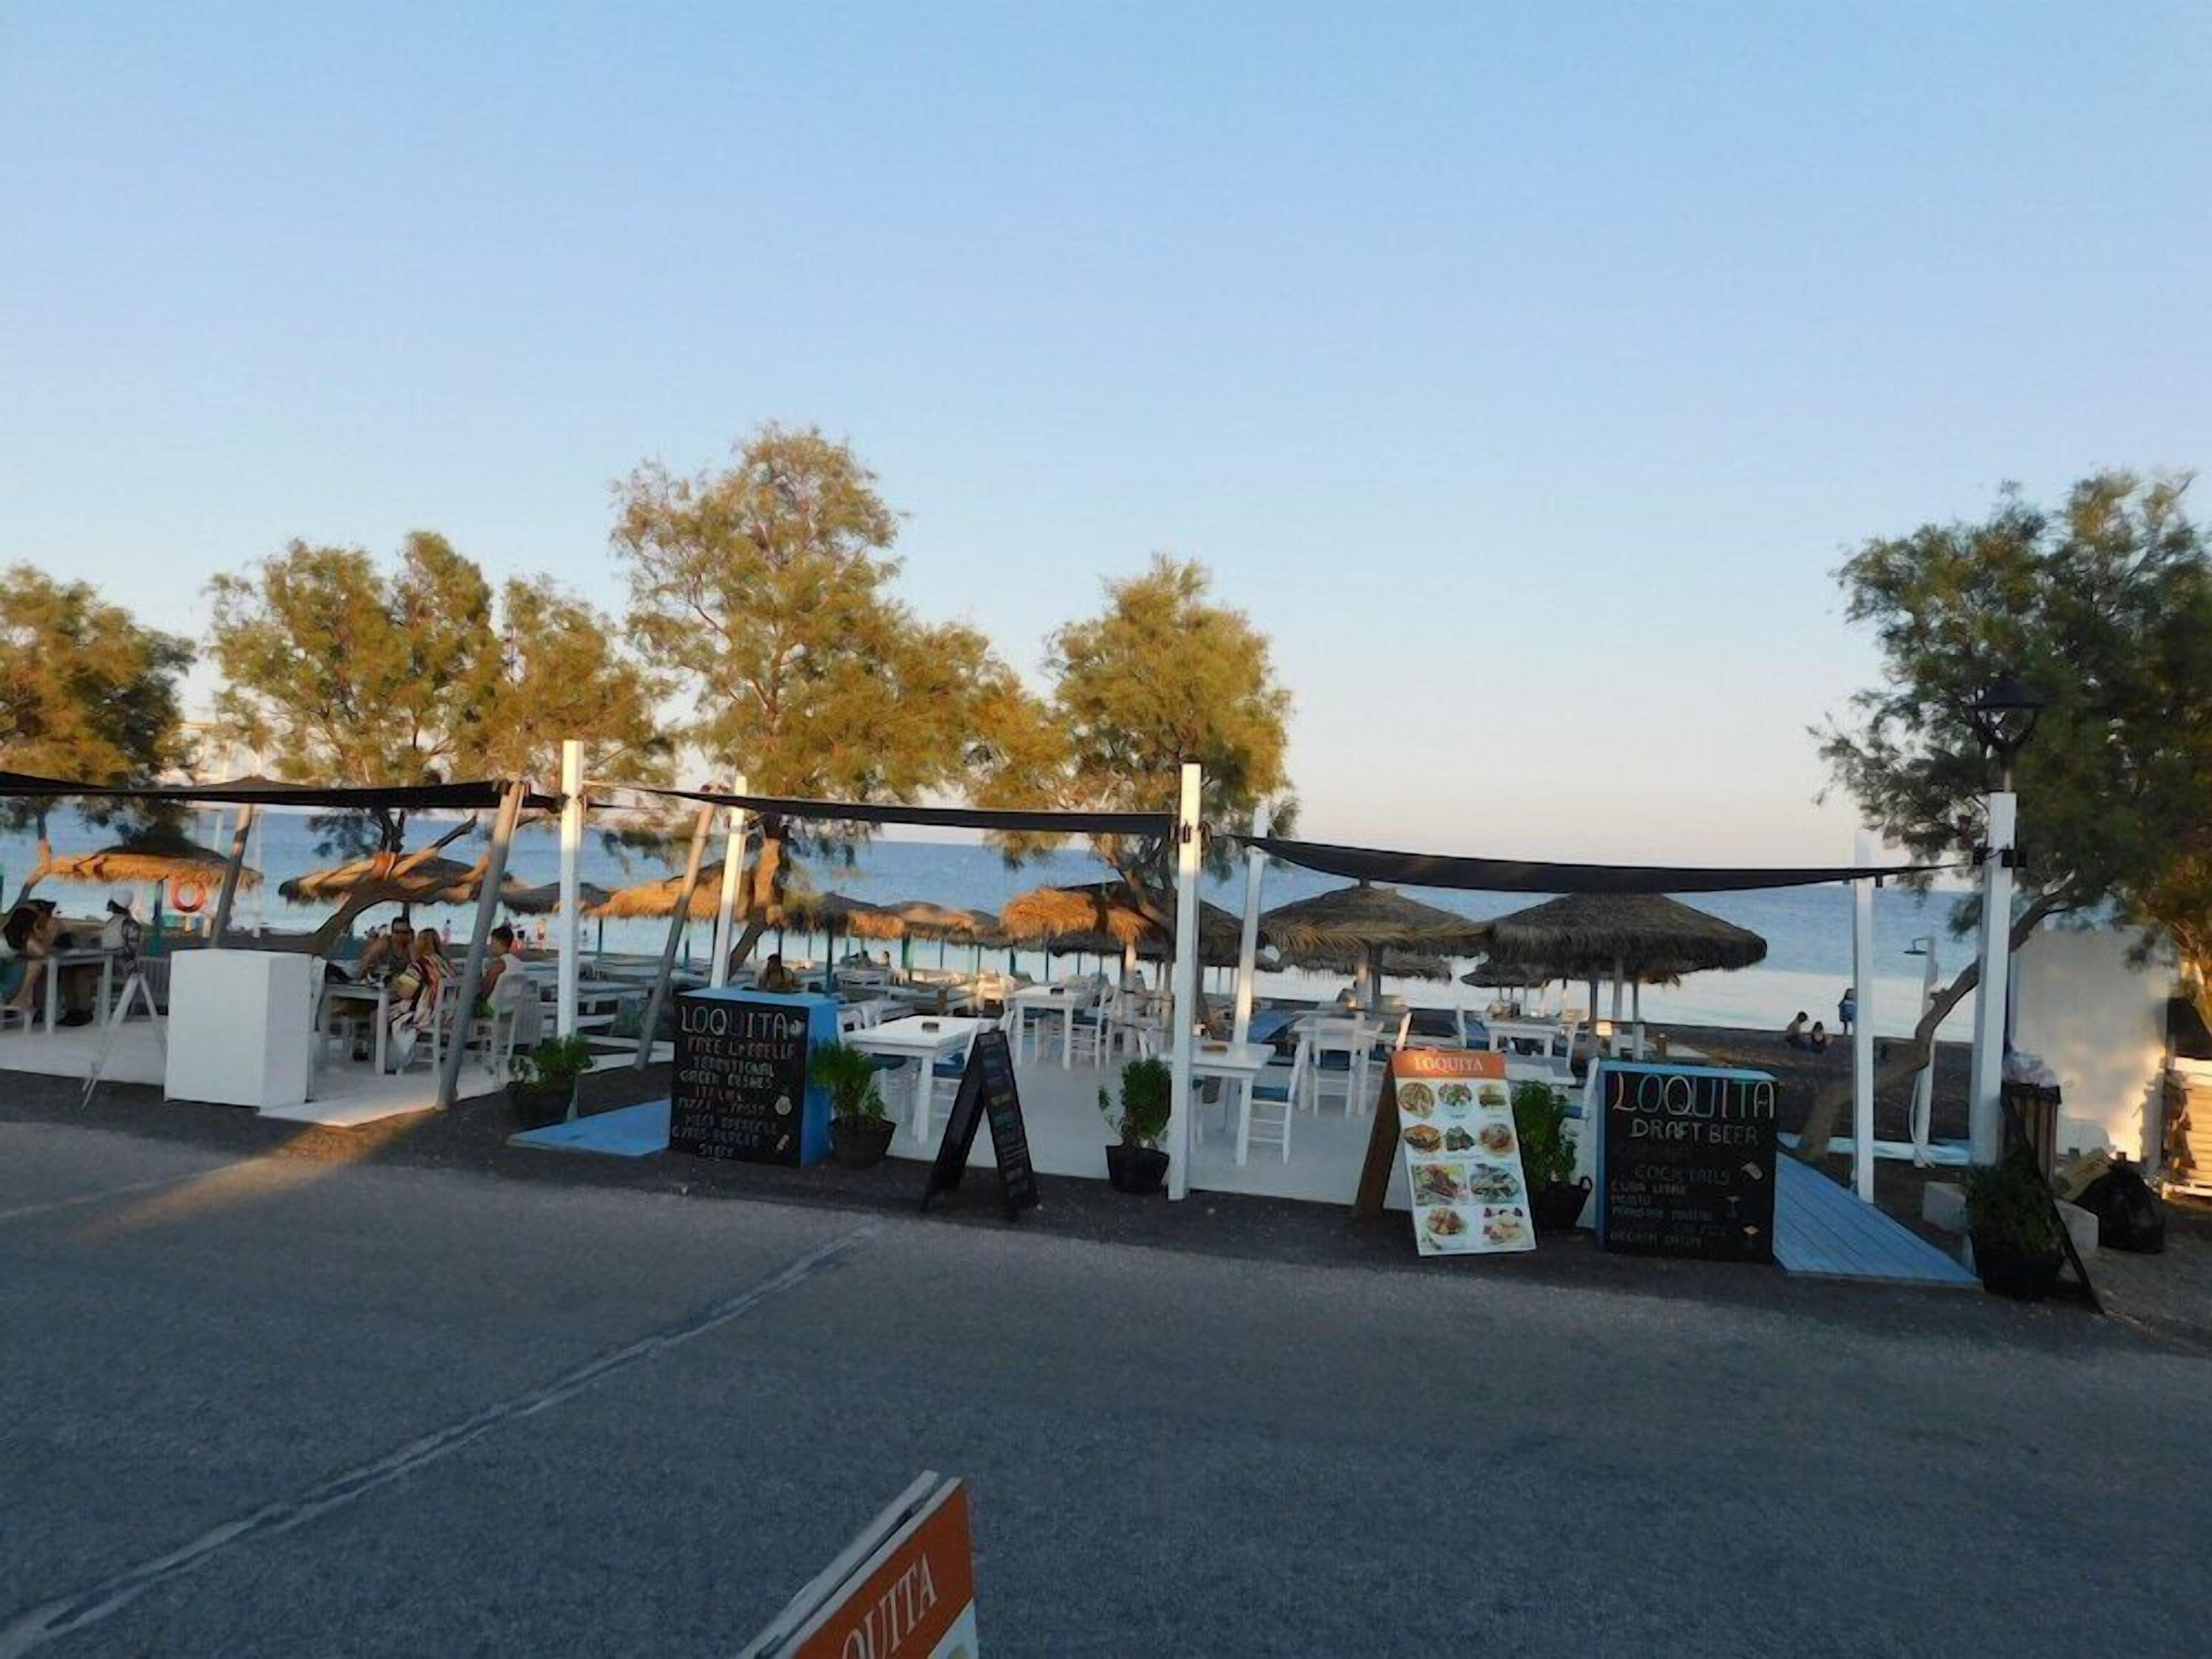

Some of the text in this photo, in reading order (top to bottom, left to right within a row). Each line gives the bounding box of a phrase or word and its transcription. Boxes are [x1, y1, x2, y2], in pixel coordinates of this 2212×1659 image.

[681, 1005, 787, 1040] LOQUITA
[1613, 1072, 1775, 1119] LOQUITA
[1631, 1118, 1759, 1146] DRAFT BEER
